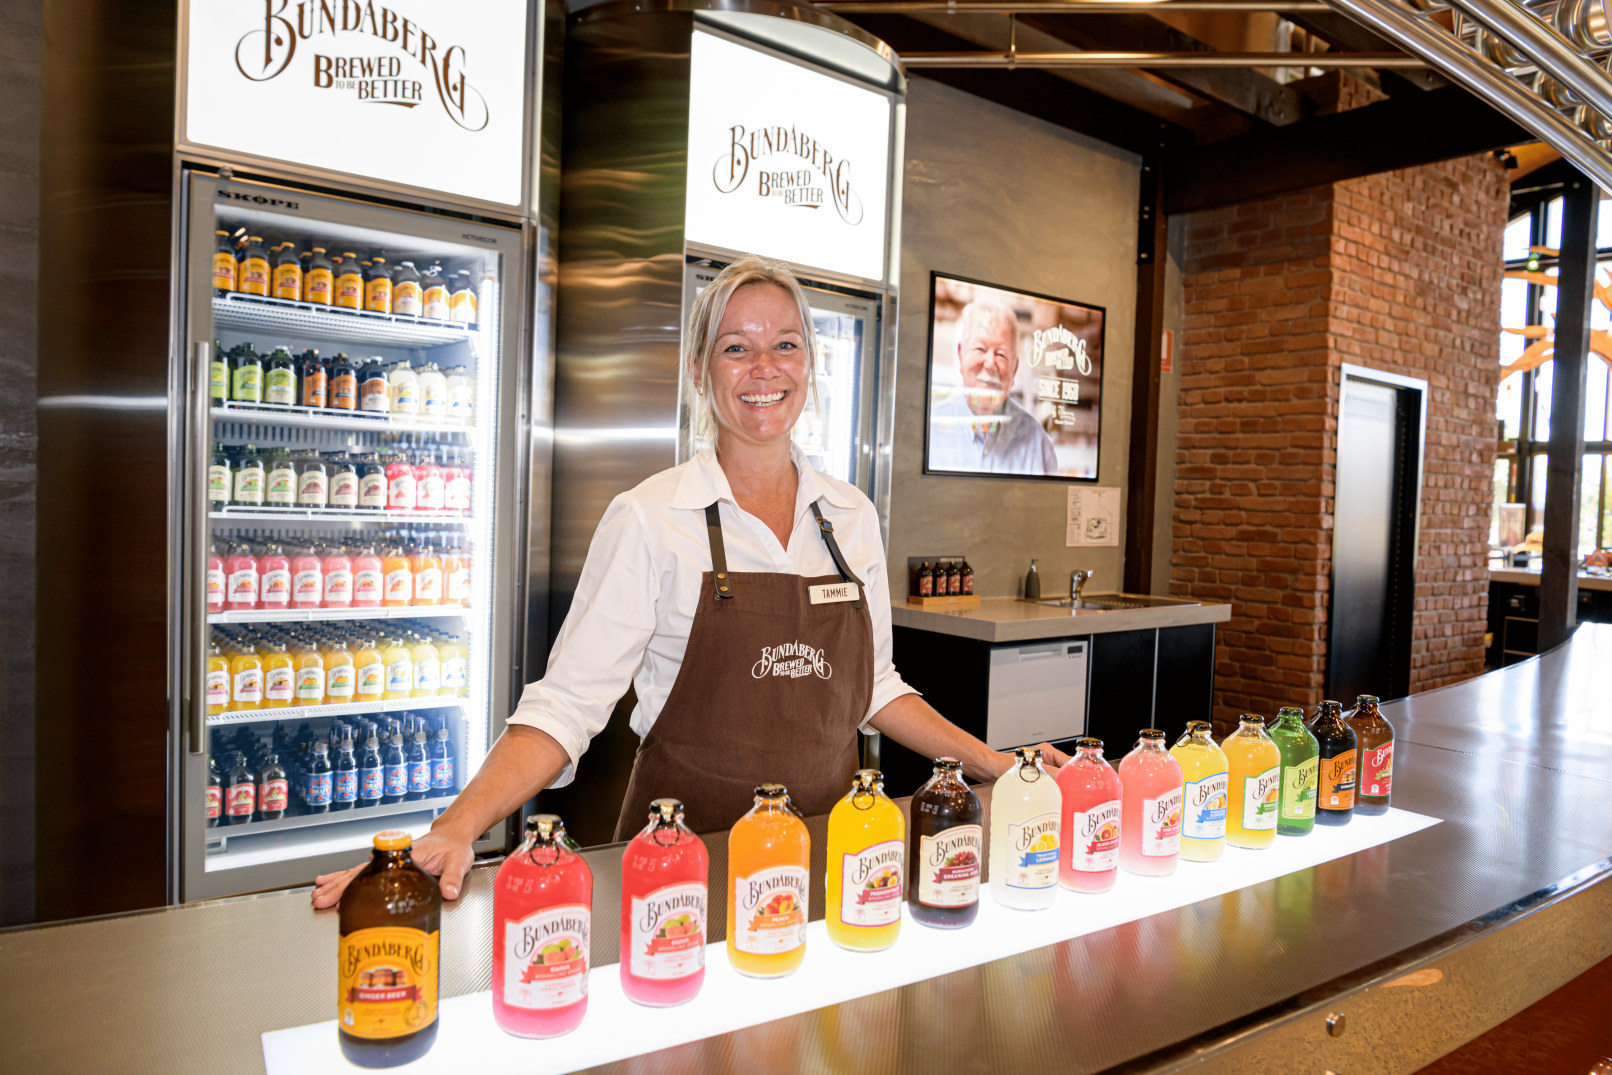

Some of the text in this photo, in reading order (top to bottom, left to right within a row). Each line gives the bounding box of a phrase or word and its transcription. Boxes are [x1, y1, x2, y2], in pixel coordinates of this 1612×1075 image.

[235, 0, 489, 131] BUNDABERG
[314, 53, 401, 88] BREWED
[358, 80, 422, 101] BETTER
[713, 123, 863, 226] BUNDABERG
[759, 170, 811, 196] BREWED
[217, 190, 299, 209] SKOPE
[785, 187, 823, 204] BETTER
[822, 588, 848, 599] TAMMIE
[752, 640, 832, 679] BUNDABERG
[773, 658, 804, 676] BREWED
[791, 665, 812, 677] BETTER
[342, 941, 431, 979] BUNDABERG
